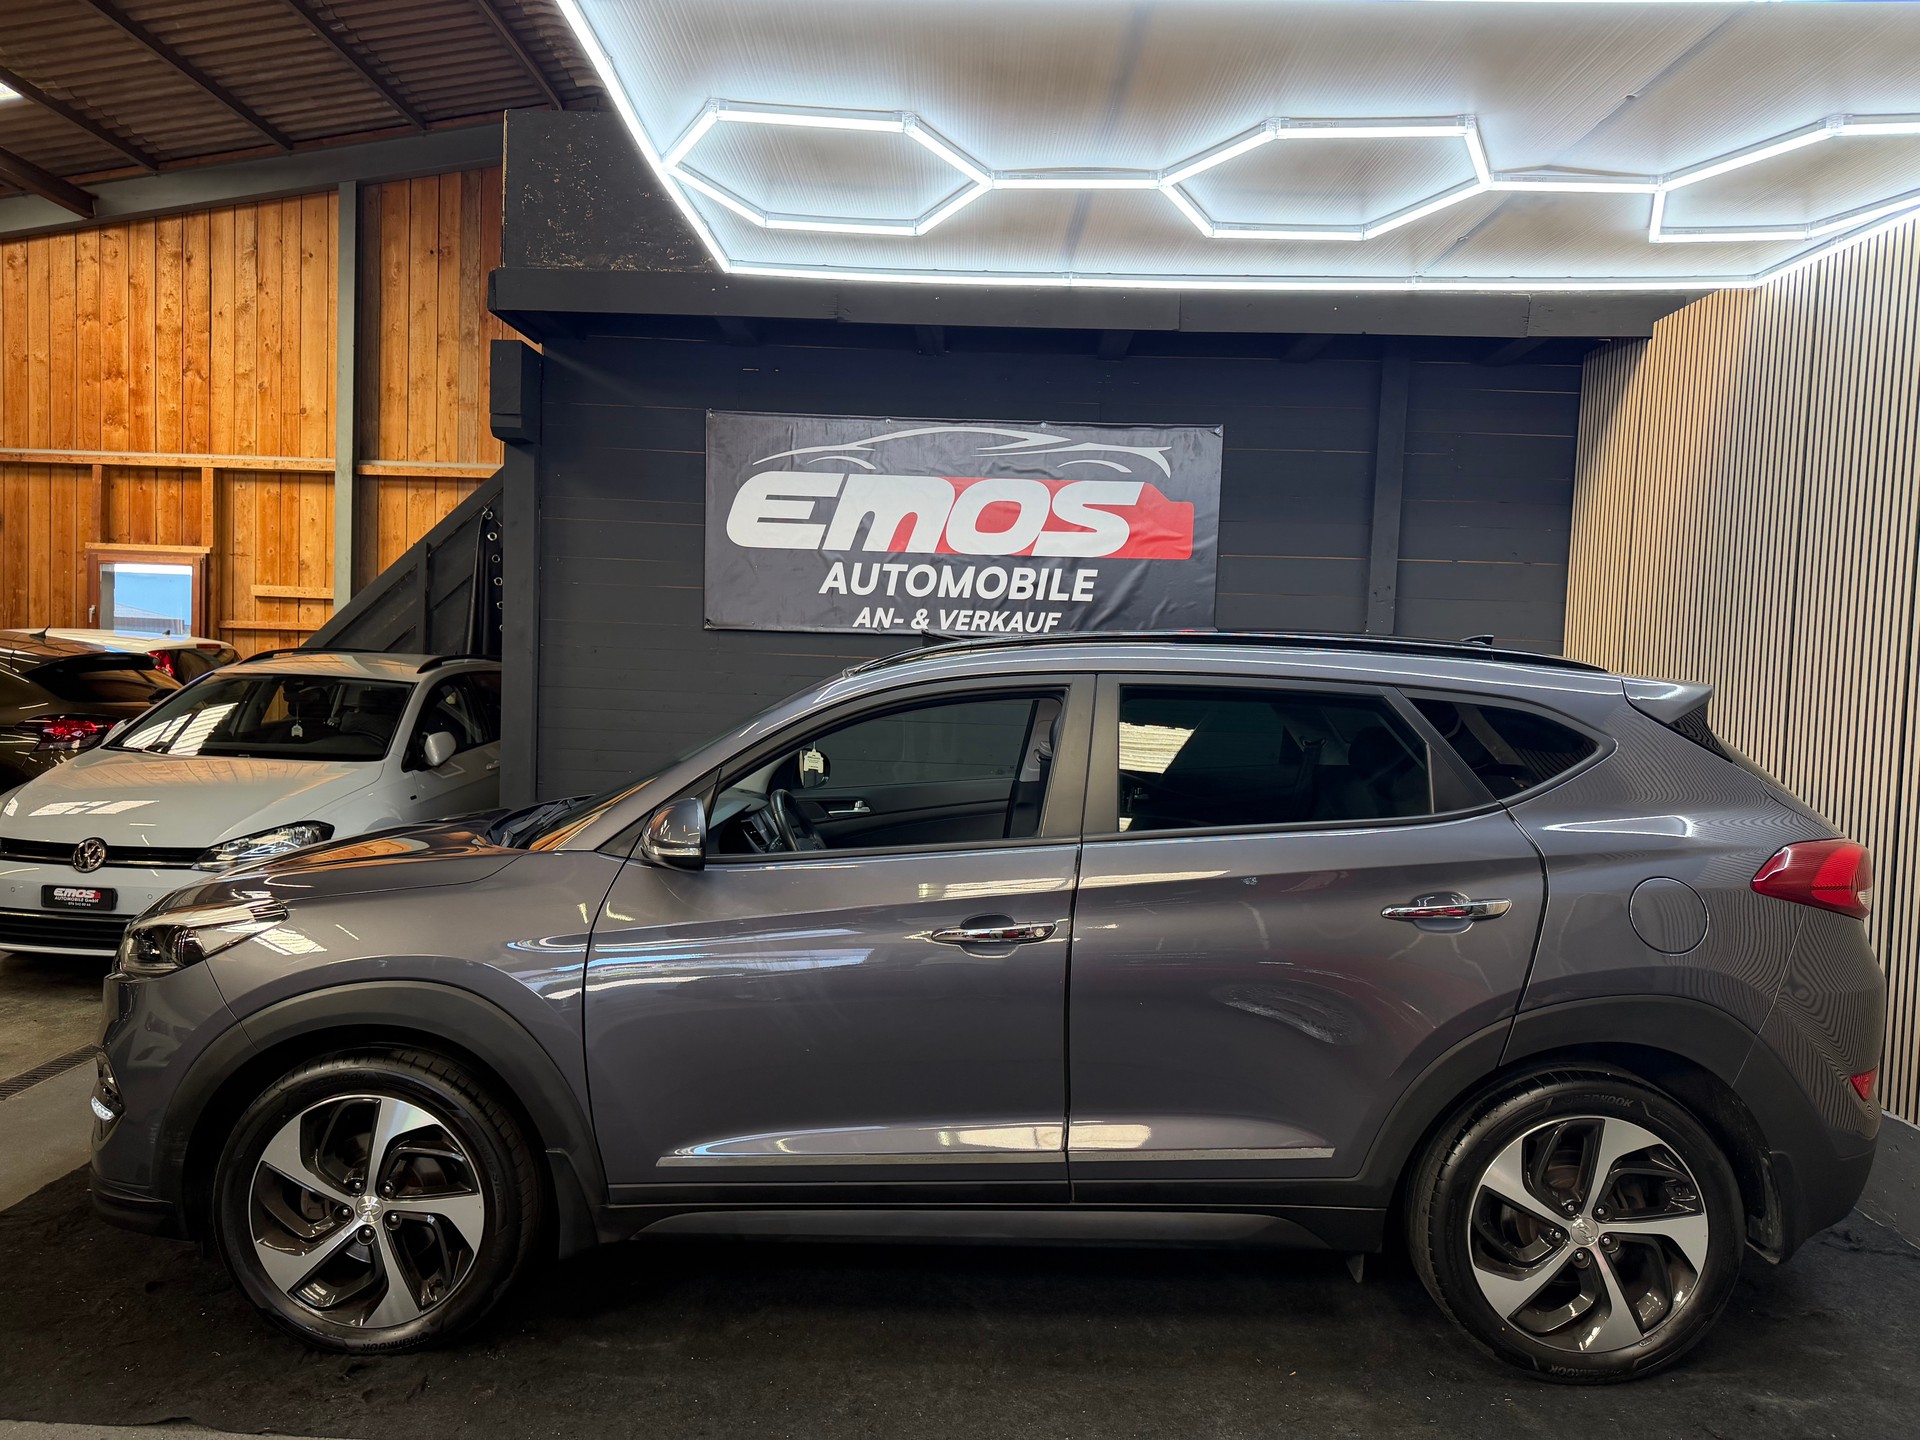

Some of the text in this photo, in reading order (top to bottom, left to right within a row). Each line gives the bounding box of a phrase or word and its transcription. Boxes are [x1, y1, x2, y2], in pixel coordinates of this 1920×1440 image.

[726, 471, 1145, 558] EMOS
[818, 561, 1099, 602] AUTOMOBILE
[852, 607, 1062, 633] AN- & VERKAUF
[54, 888, 96, 899] EMOS
